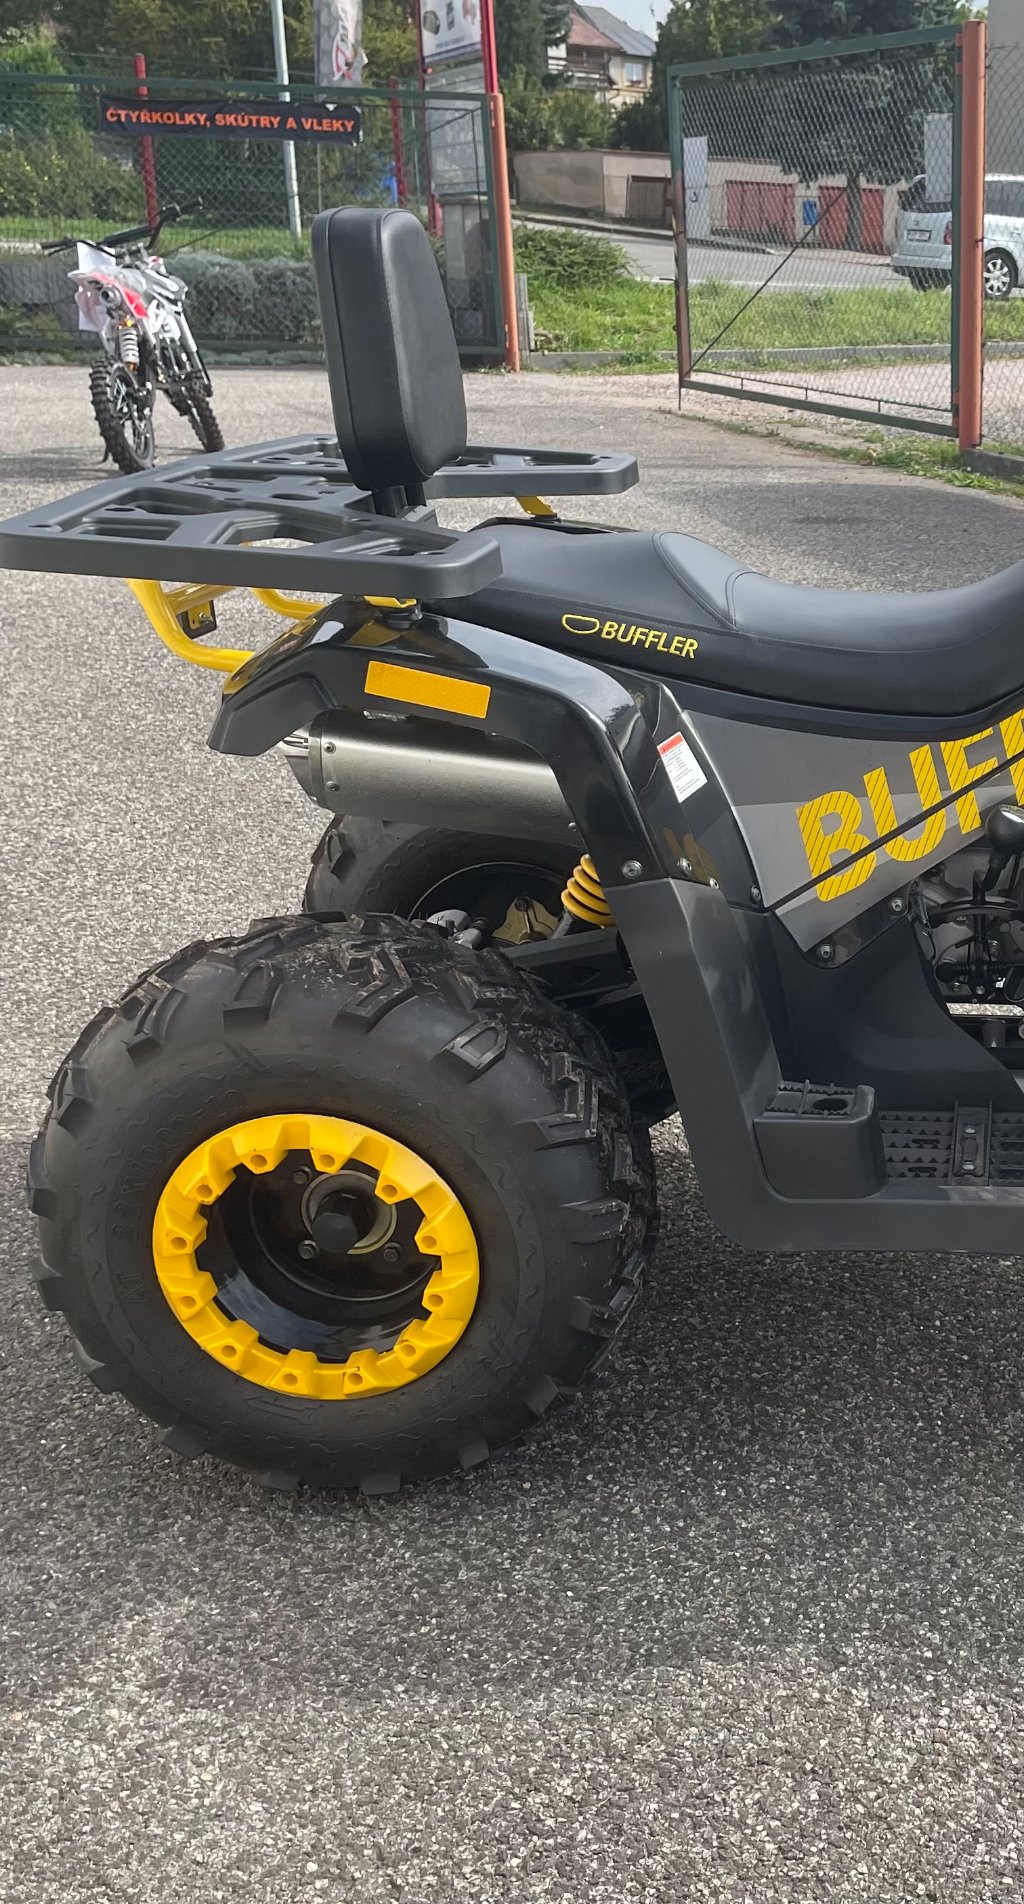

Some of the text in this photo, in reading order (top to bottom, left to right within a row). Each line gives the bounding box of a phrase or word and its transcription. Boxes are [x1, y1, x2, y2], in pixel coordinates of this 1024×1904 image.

[106, 108, 355, 132] ČTYŘKOLKY, SKÚTRY A VLEKY
[600, 620, 699, 659] BUFFLER
